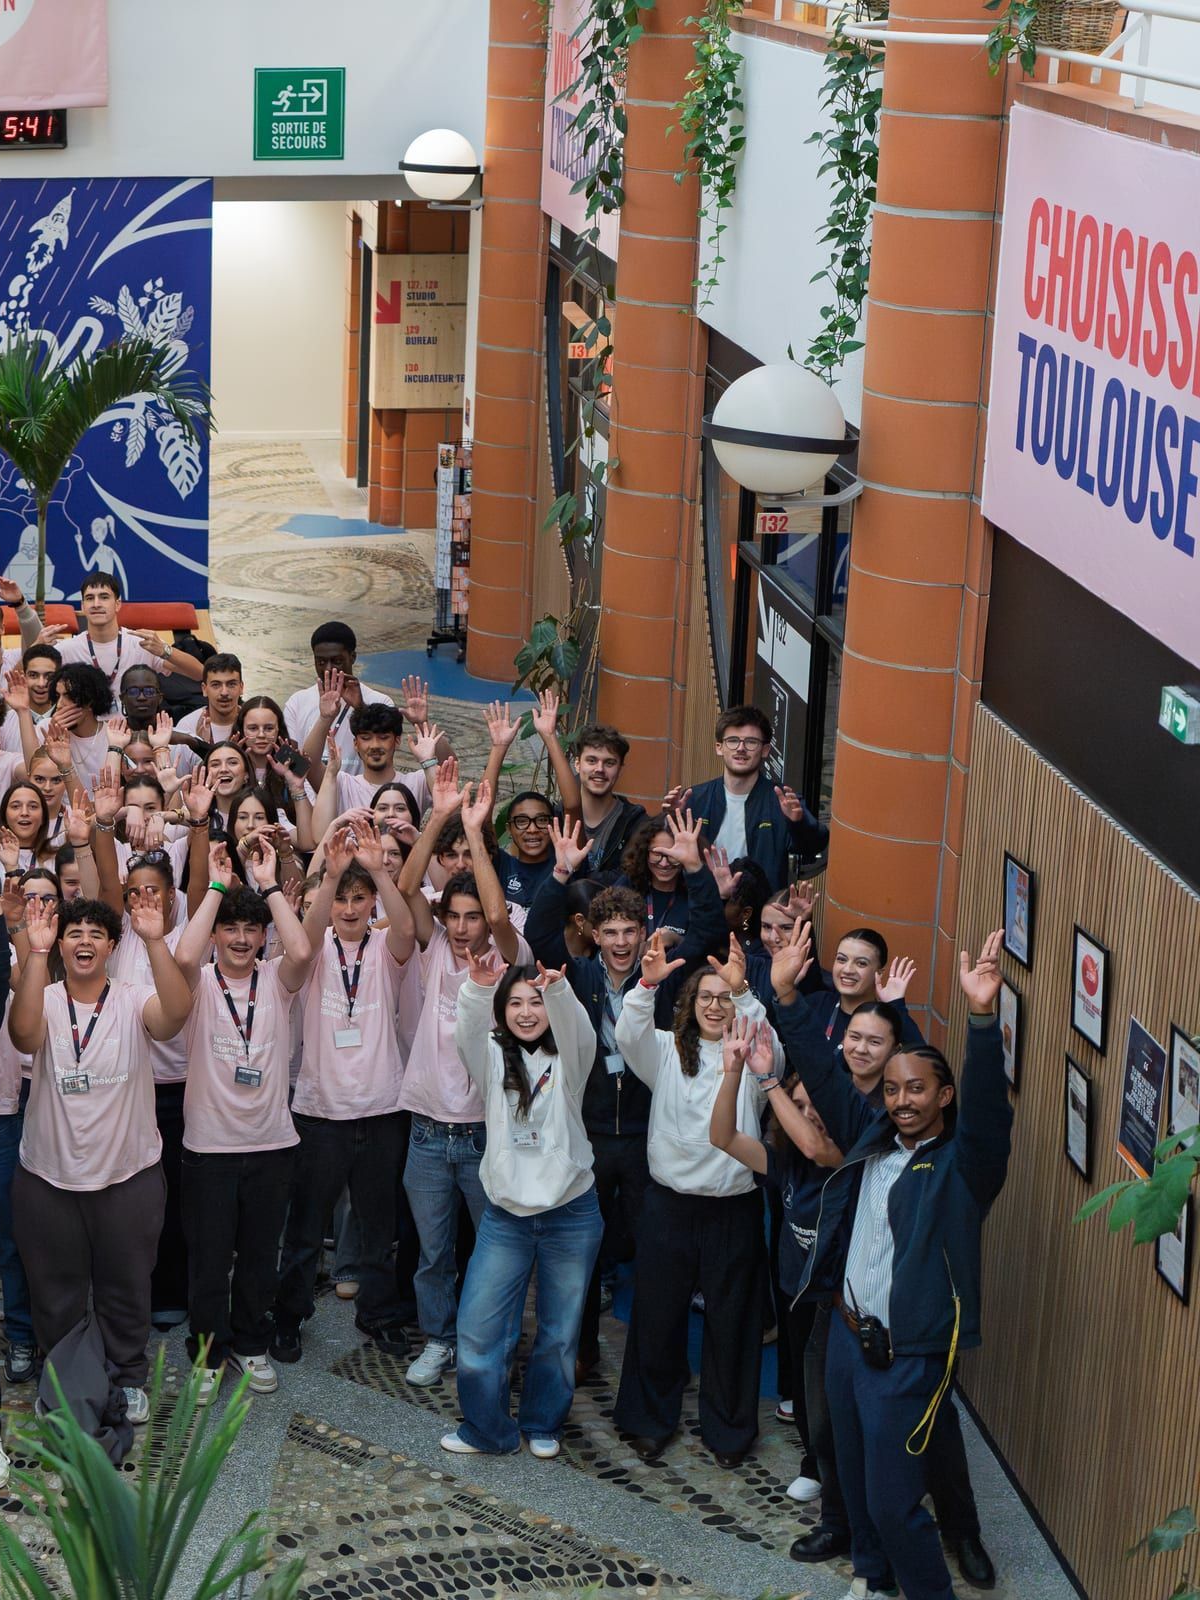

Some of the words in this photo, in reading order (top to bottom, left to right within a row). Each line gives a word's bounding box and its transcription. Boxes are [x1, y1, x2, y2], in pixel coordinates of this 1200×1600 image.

[5, 115, 53, 138] 5:41
[271, 122, 310, 134] SORTIE
[313, 121, 326, 134] DE
[271, 136, 327, 149] SECOURS
[406, 291, 436, 300] STUDIO
[1025, 197, 1200, 400] CHOISISS
[405, 336, 438, 345] BUREAU
[404, 374, 454, 383] INCUBATEUR
[1016, 331, 1200, 558] TOULOUSE
[759, 515, 790, 533] 132
[775, 611, 788, 646] 132
